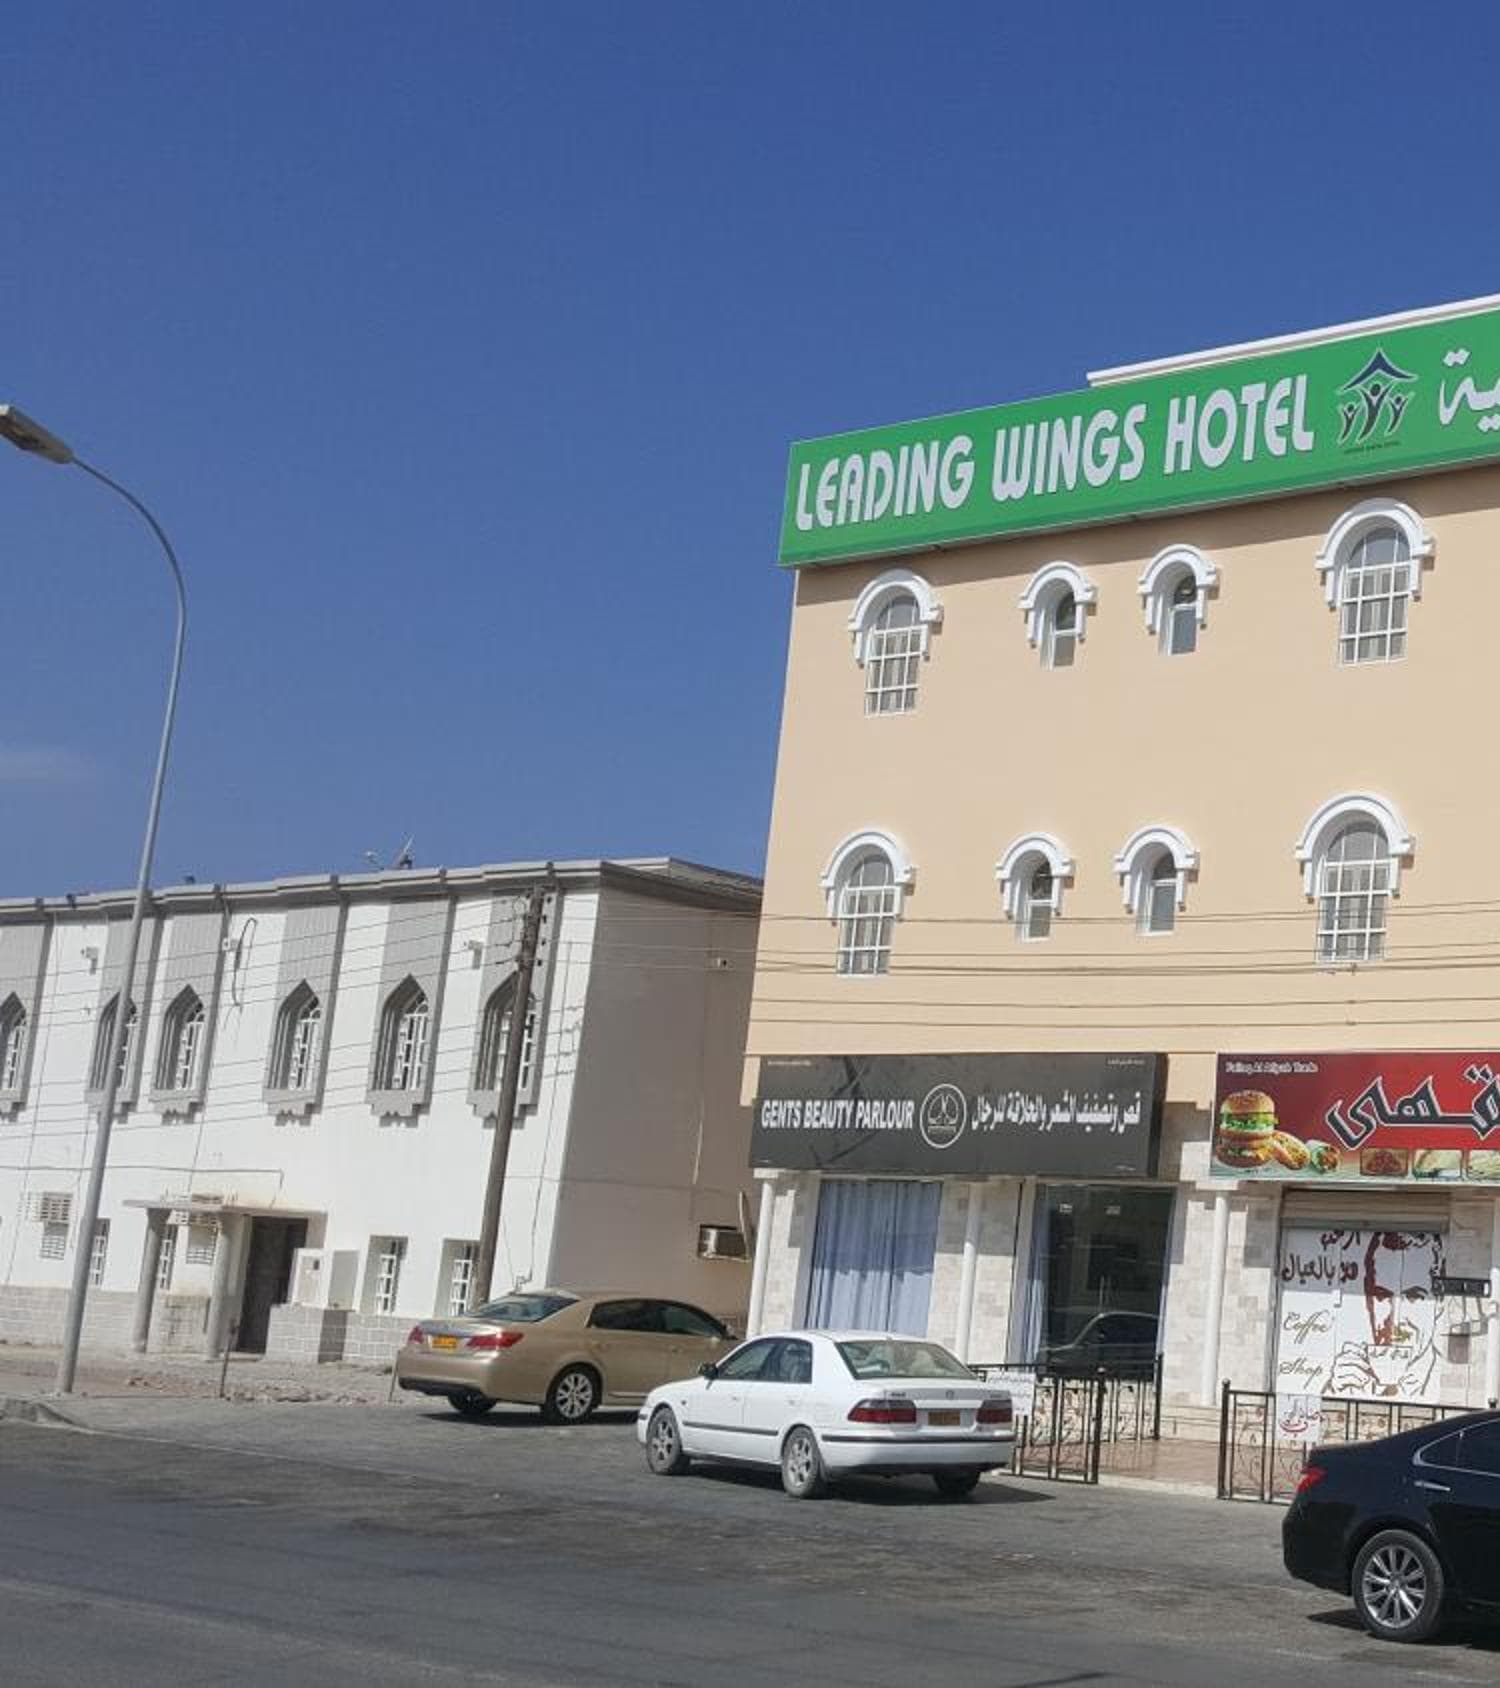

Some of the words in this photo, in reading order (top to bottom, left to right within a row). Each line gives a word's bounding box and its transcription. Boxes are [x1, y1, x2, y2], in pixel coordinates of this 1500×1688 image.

[795, 434, 974, 531] LEADING
[992, 402, 1148, 500] WINGS
[1163, 373, 1315, 474] HOTEL
[761, 1099, 802, 1129] GENTS
[803, 1099, 854, 1129] BEAUTY
[855, 1099, 915, 1129] PARLOUR
[1283, 1309, 1331, 1344] Coffee
[1279, 1357, 1323, 1389] Shop
